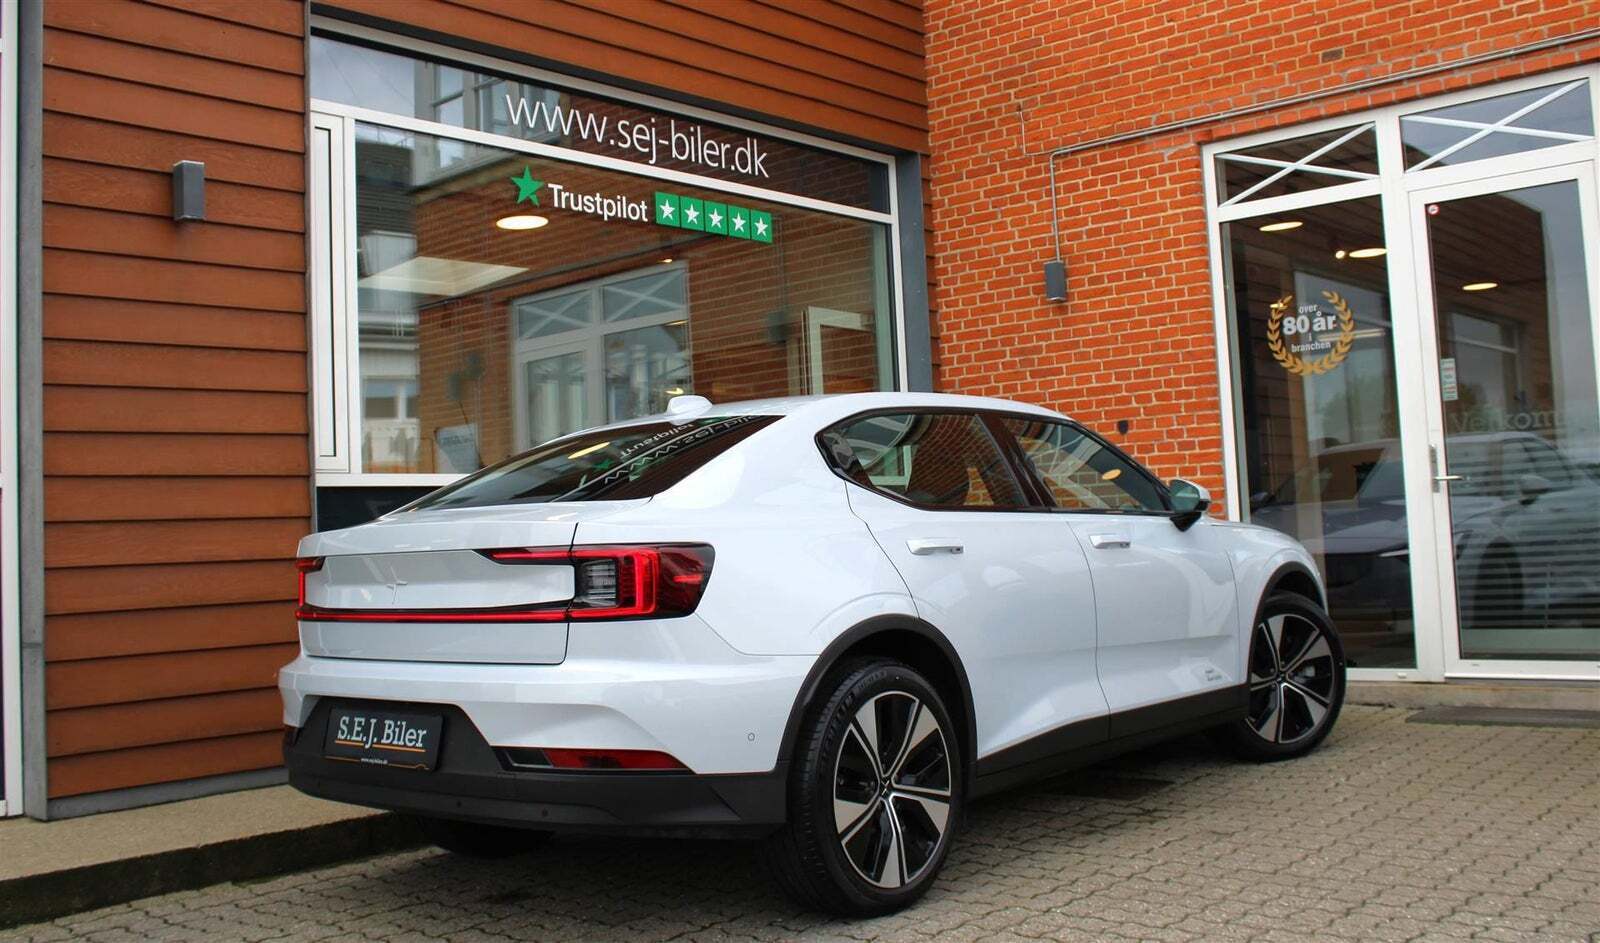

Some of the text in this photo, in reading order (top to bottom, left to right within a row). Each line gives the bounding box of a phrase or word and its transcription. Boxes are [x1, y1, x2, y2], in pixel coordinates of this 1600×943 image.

[505, 94, 769, 178] www.sej-biler.dk
[547, 182, 649, 223] Trustpilot
[1299, 304, 1317, 313] over
[1283, 311, 1336, 335] 80 år
[1291, 341, 1331, 353] branchen
[337, 716, 427, 749] S.E.J. Biler
